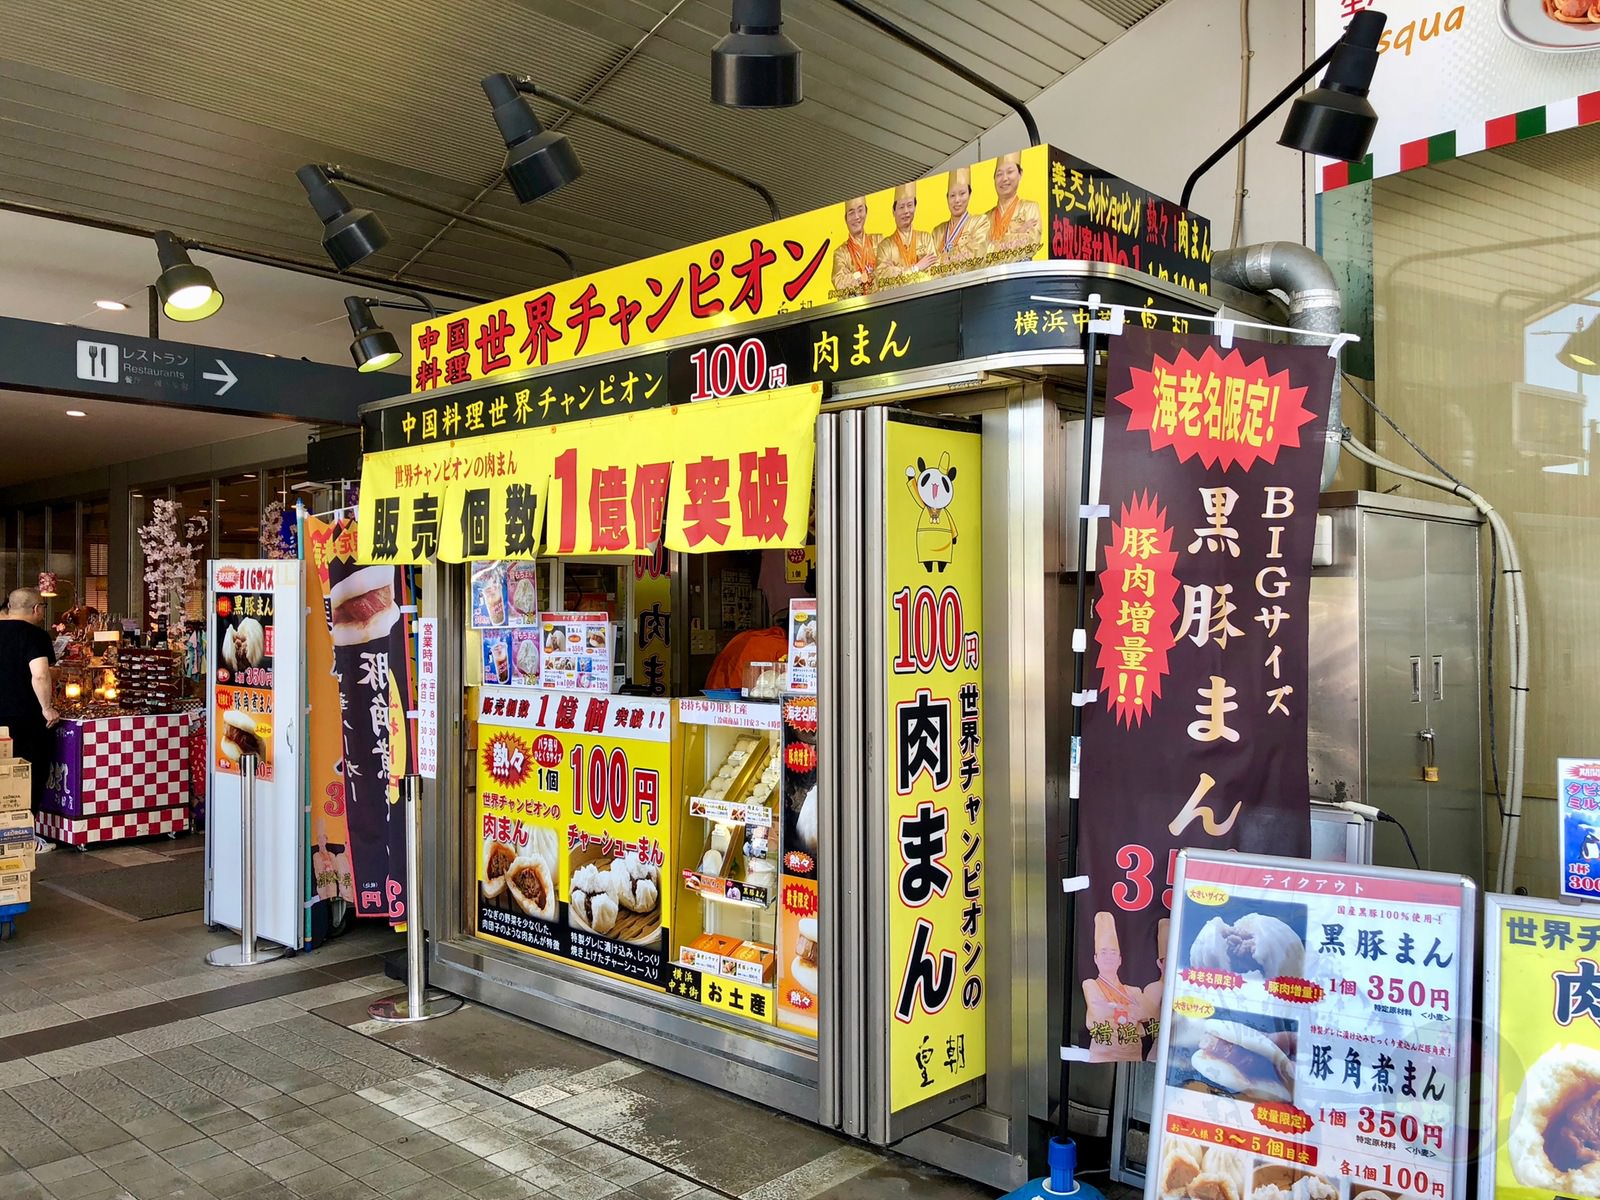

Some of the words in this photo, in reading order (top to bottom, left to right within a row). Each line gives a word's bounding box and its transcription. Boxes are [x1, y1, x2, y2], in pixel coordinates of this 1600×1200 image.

[1052, 161, 1085, 196] 楽天
[1052, 184, 1087, 212] ヤフー
[474, 238, 831, 376] 世界チャンピオン
[417, 318, 470, 353] 中国
[123, 347, 188, 366] レストラン
[123, 363, 185, 380] Restaurants
[415, 352, 472, 391] 料理
[402, 373, 664, 445] 中国料理世界チャンピオン
[690, 338, 787, 402] 100円
[812, 320, 911, 373] 肉まん
[1151, 366, 1280, 448] 海老名限定!
[394, 449, 518, 490] 世界チャンピオンの肉まん
[239, 567, 274, 591] BIGサイズ
[233, 595, 273, 616] 黒豚まん
[1114, 526, 1163, 706] 豚肉増量!!
[1255, 486, 1295, 717] BIGサイズ
[893, 585, 978, 674] 100円
[422, 623, 434, 674] 営業時間
[1168, 486, 1247, 837] 黒豚まん
[234, 691, 273, 714] 豚角煮まん
[481, 696, 531, 719] 販売個数
[493, 742, 525, 777] 熱々
[537, 769, 559, 792] 1個
[569, 744, 660, 826] 100円
[482, 792, 561, 820] 世界チャンピオンの
[482, 812, 529, 847] 肉まん
[567, 823, 664, 867] チャーシューまん
[959, 683, 983, 1010] 世界チャンピオンの
[894, 687, 957, 1024] 肉まん
[1189, 888, 1226, 902] 大きいサイズ
[1261, 874, 1365, 894] テイクアウト
[481, 919, 561, 951] 肉団子のような肉あんが特徴
[482, 908, 552, 936] つなぎの野菜を少なくした、
[570, 932, 661, 967] 特製ダレに漬け込み、じっくり
[570, 945, 659, 980] 焼き上げたチャーシュー入り
[1318, 923, 1453, 969] 黒豚まん
[1187, 969, 1236, 988] 海老名限定!
[1329, 978, 1357, 996] 1個
[1367, 974, 1450, 1012] 350円
[708, 981, 765, 1017] お土産
[1173, 999, 1211, 1015] 大きいサイズ
[1374, 1004, 1412, 1016] 特定原材料
[1308, 1044, 1446, 1102] 豚角煮まん
[1257, 1107, 1306, 1129] 数量限定!
[1317, 1107, 1347, 1128] 1個
[1358, 1106, 1443, 1149] 350円
[1355, 1134, 1396, 1150] 特定原材料
